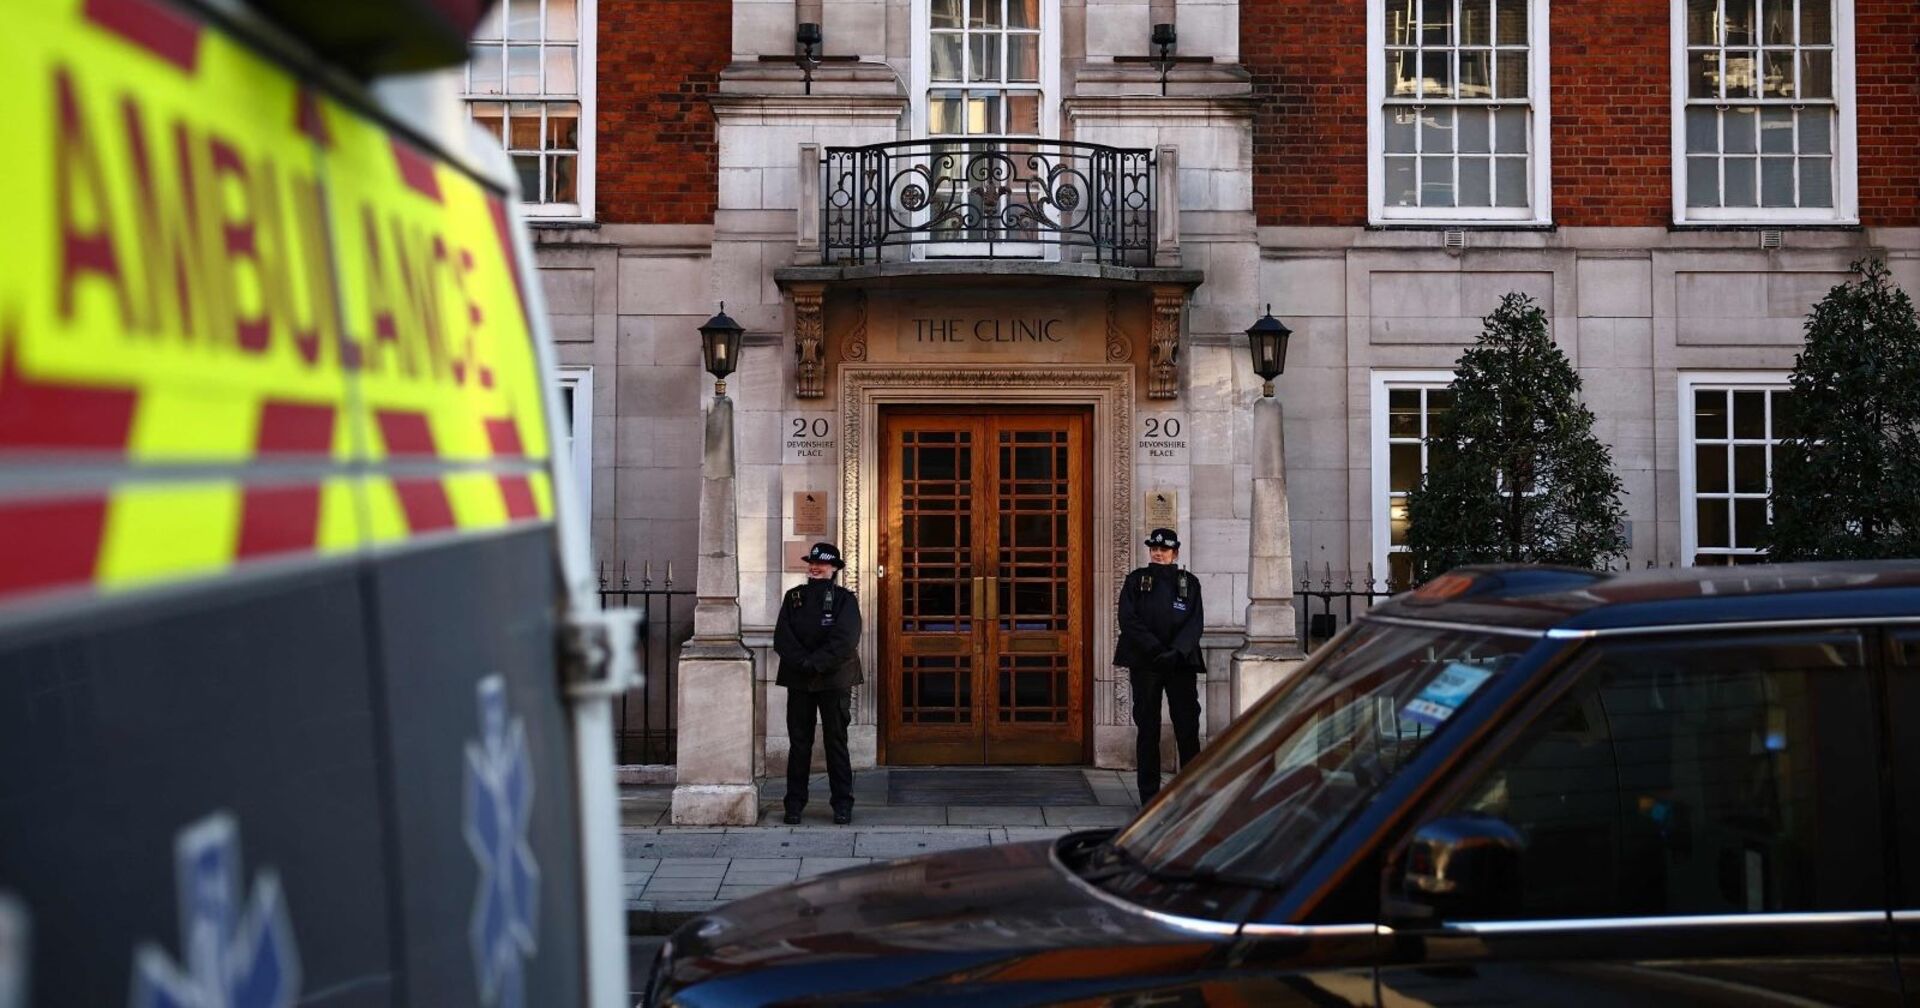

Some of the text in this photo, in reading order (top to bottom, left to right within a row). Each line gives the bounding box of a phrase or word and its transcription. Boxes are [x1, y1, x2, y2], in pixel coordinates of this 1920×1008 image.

[51, 57, 496, 390] AMBULANCE
[911, 319, 1065, 343] THE CLINIC
[792, 417, 829, 438] 20
[1144, 417, 1180, 438] 20
[786, 440, 835, 448] DEVONSHIRE
[1139, 440, 1187, 448] DEVONSHIRE
[797, 449, 823, 457] PLACE
[1149, 449, 1175, 457] PLACE
